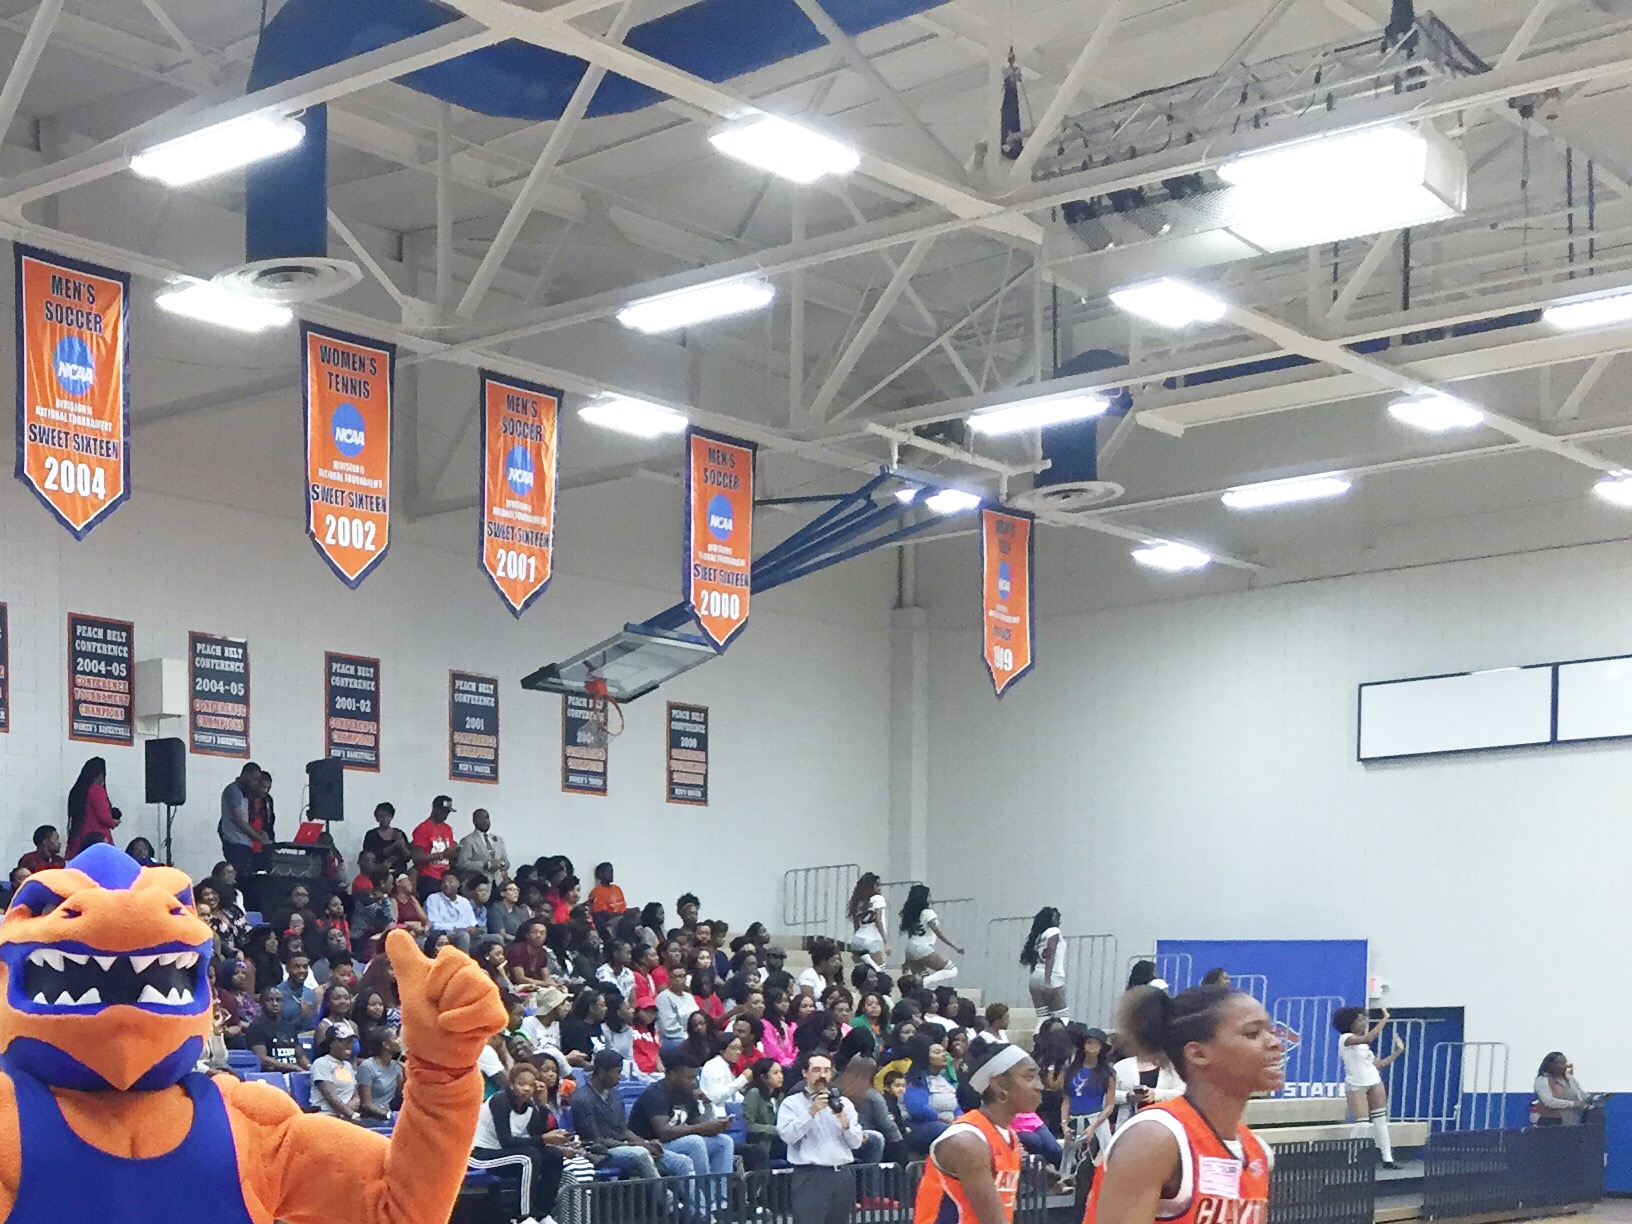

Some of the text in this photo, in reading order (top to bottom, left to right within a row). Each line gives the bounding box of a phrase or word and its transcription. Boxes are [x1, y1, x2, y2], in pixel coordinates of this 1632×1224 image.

[51, 275, 96, 305] MEN'S
[45, 300, 103, 334] SOCCER
[320, 344, 377, 376] WOMEN'S
[58, 361, 94, 384] NCAA
[327, 371, 370, 399] TENNIS
[506, 394, 538, 418] MEN'S
[335, 427, 365, 446] NCAA
[501, 416, 543, 441] SOCCER
[28, 423, 119, 459] SWEET SIXTEEN
[44, 456, 106, 500] 2004
[508, 468, 533, 486] NCAA
[703, 468, 740, 490] SOCCER
[311, 484, 388, 513] SWEET SIXTEEN
[325, 514, 376, 551] 2002
[487, 521, 515, 541] SWEET
[710, 514, 733, 531] NCAA
[496, 549, 536, 582] 2001
[701, 590, 740, 620] 2000
[76, 625, 127, 643] PEACH BELT
[75, 639, 128, 658] CONFERENCE
[196, 643, 243, 659] PEACH BELT
[77, 657, 127, 677] 2004-05
[195, 657, 244, 673] CONFERENCE
[332, 662, 355, 675] PEACH
[195, 677, 245, 696] 2004-05
[331, 676, 376, 691] CONFERENCE
[335, 696, 371, 713] 2001-02
[465, 716, 485, 730] 2001
